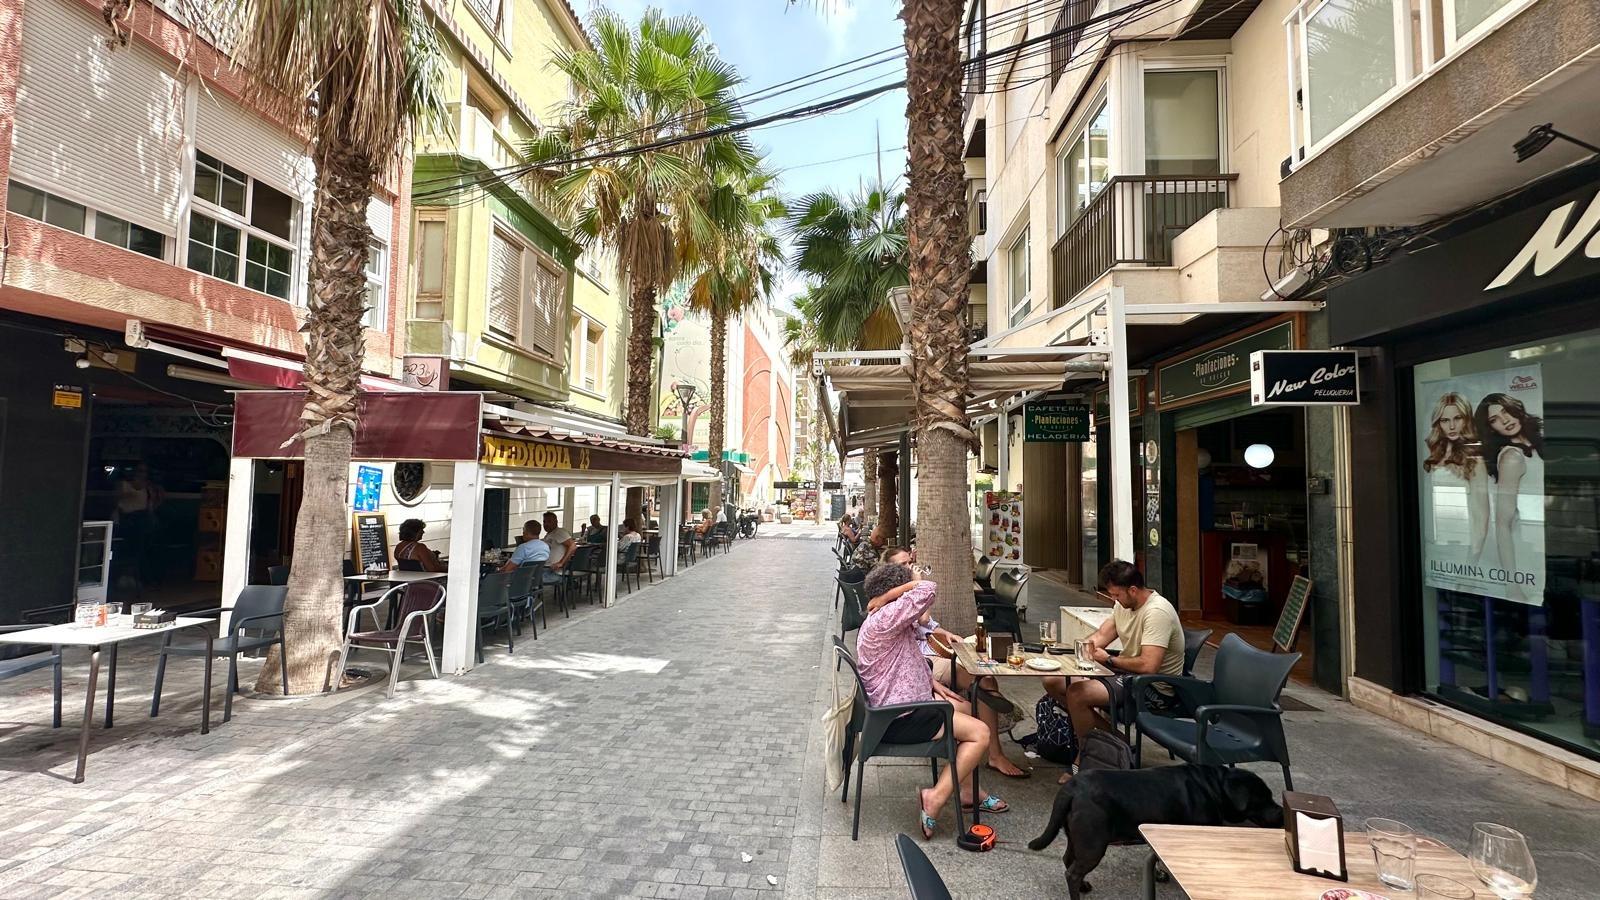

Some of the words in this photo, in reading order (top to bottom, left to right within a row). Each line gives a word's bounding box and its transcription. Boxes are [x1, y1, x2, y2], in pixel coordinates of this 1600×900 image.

[1195, 354, 1235, 376] Plantaciones
[1267, 379, 1307, 398] New
[1309, 363, 1356, 385] Color
[1034, 415, 1079, 424] Plantaciones
[481, 435, 572, 469] MEDIODIA
[580, 448, 590, 470] 23
[1430, 559, 1485, 579] ILLUMINA
[1489, 568, 1536, 586] COLOR
